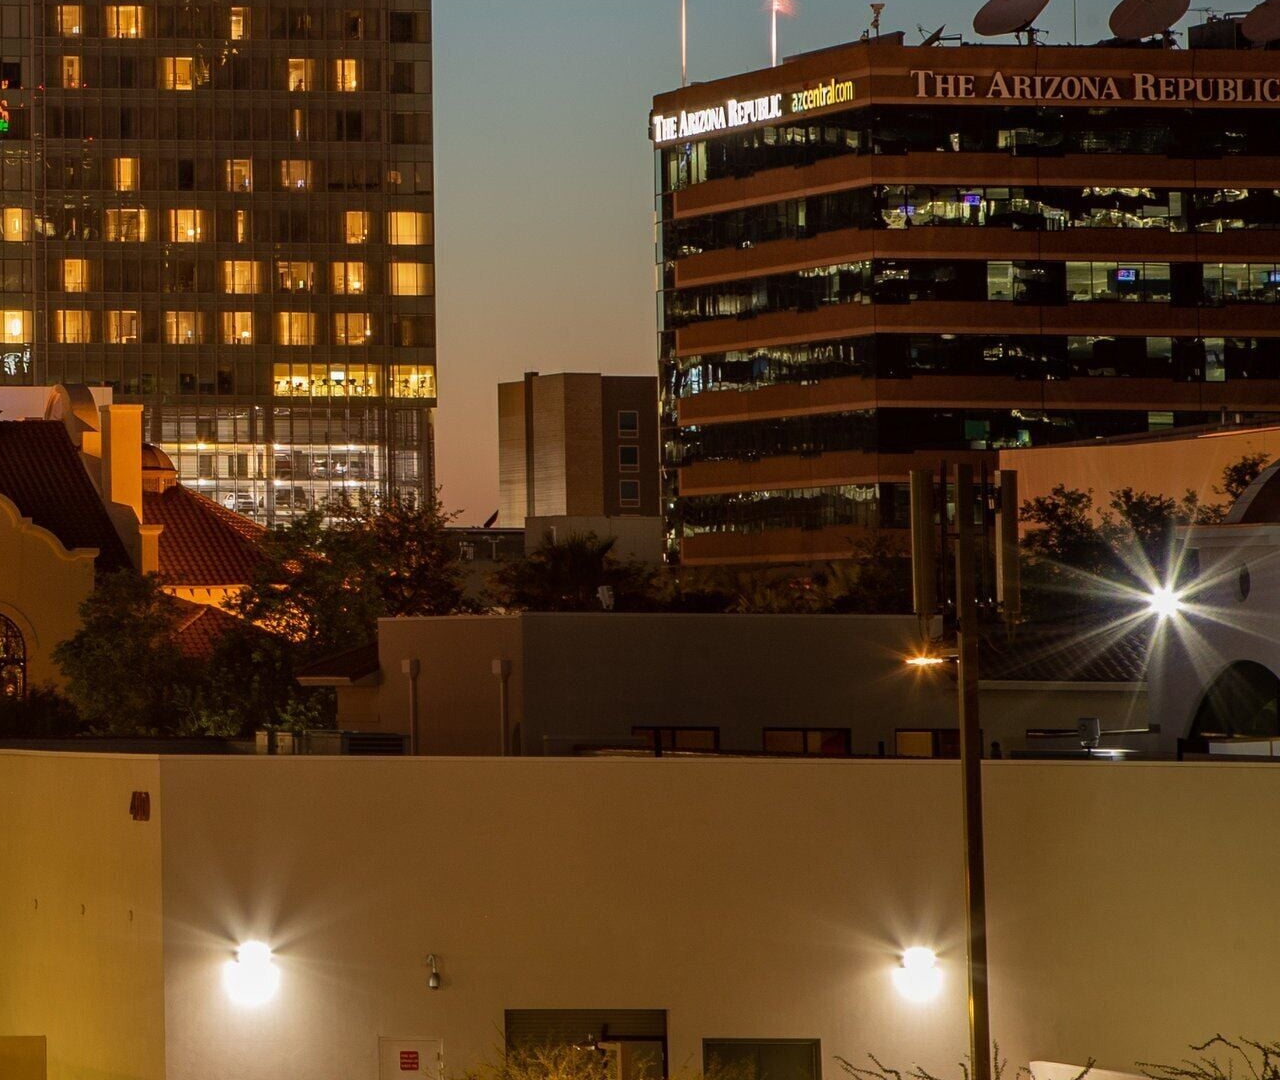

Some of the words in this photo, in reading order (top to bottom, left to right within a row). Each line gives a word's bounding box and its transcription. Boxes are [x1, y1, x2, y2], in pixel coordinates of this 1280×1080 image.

[911, 70, 975, 98] THE
[986, 71, 1121, 100] ARIZONA
[1133, 73, 1280, 102] REPUBLIC
